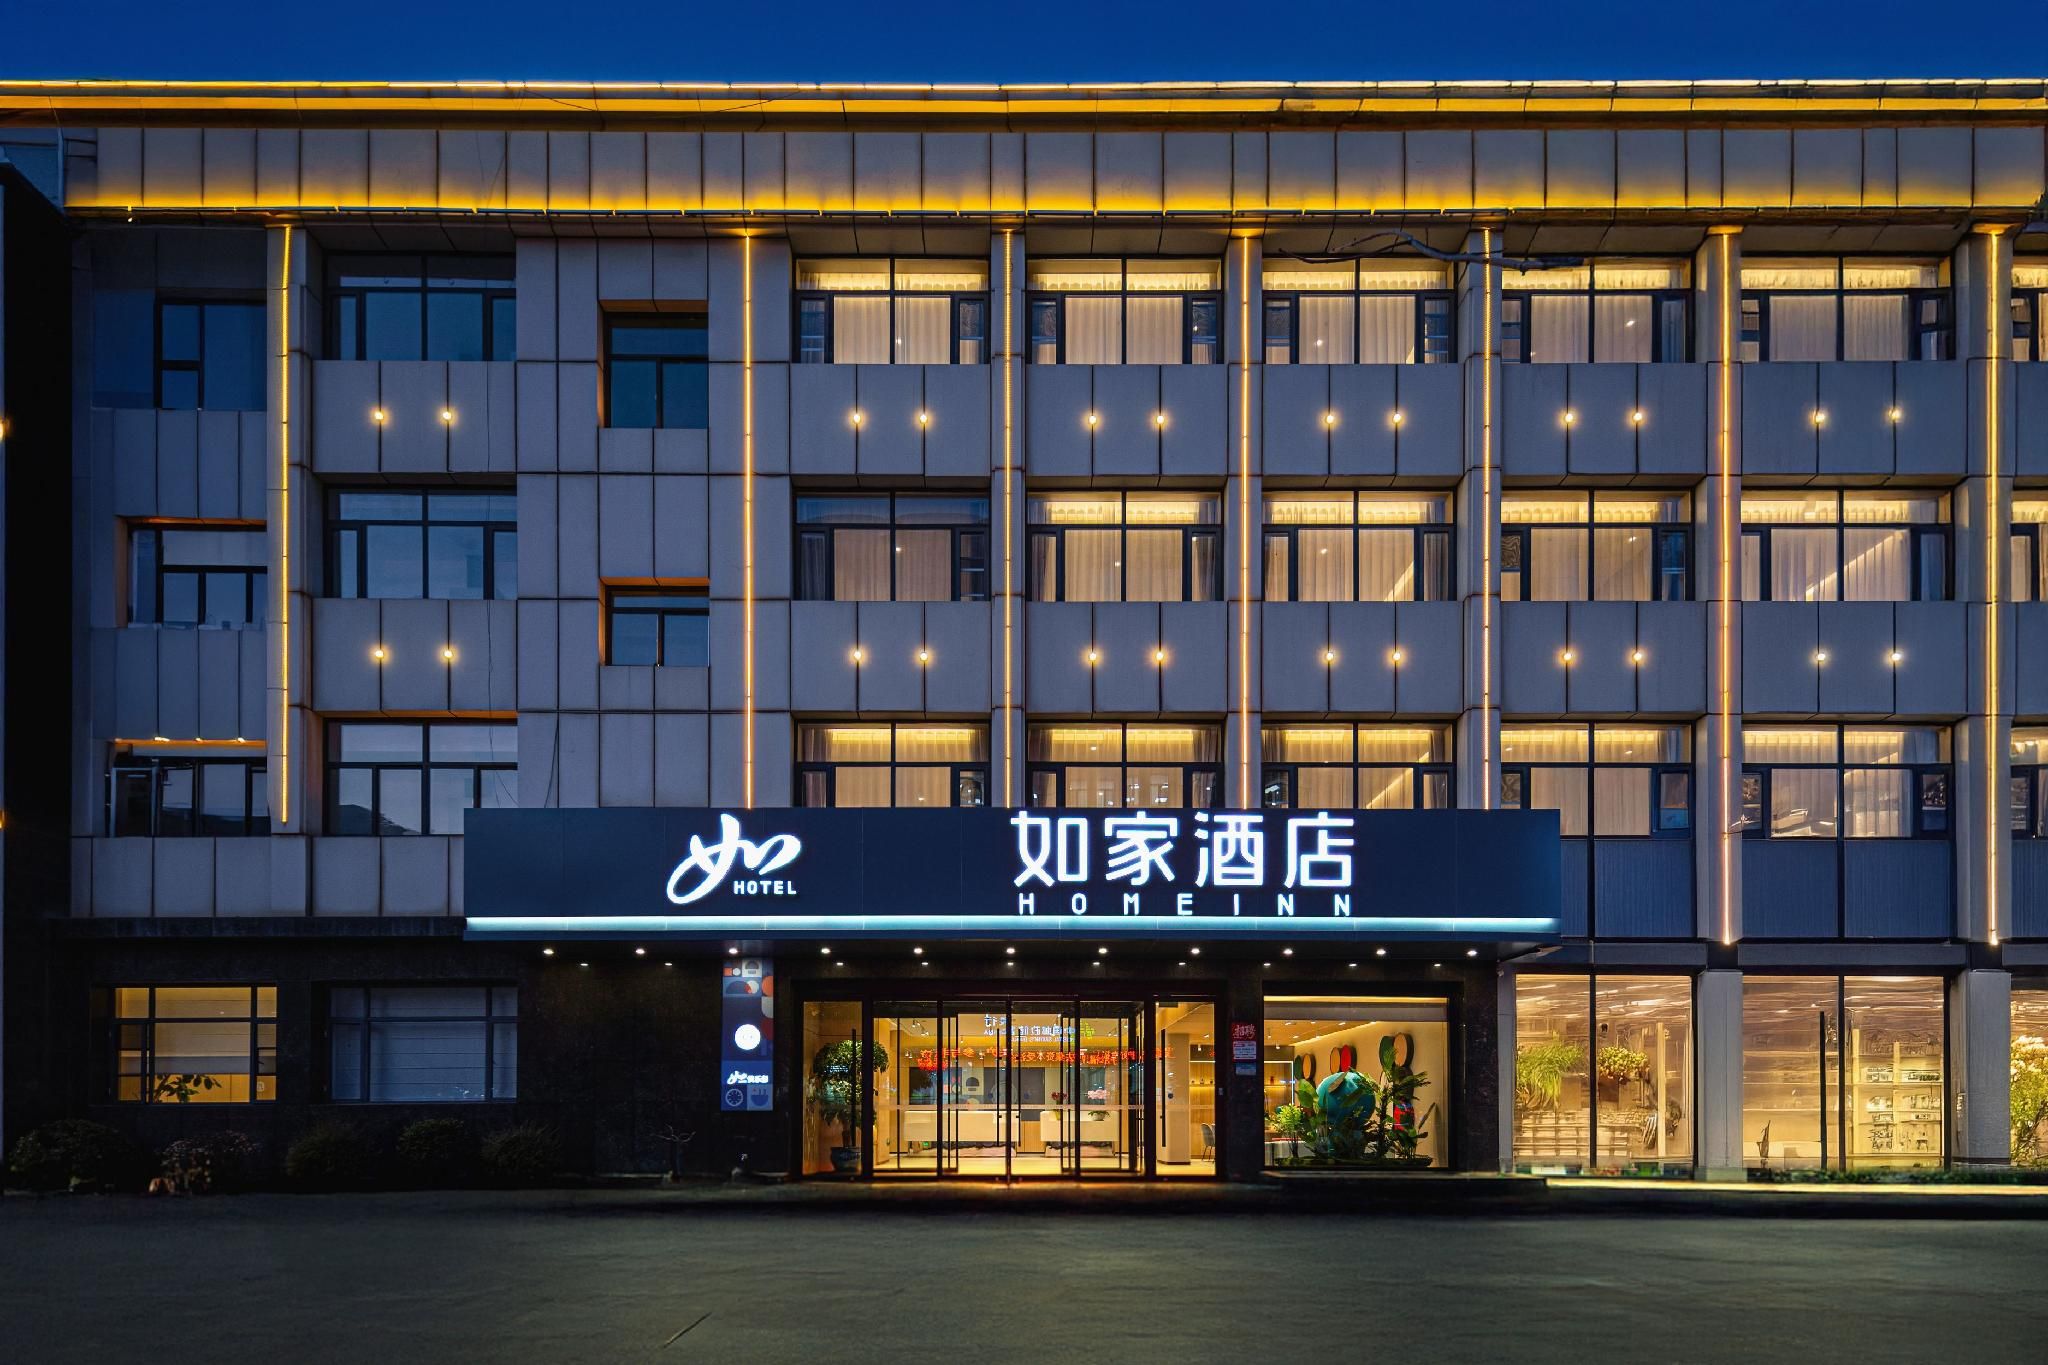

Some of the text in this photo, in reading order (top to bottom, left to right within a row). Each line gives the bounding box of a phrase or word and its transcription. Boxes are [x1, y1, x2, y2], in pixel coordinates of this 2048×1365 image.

[1010, 810, 1355, 888] 如家酒店
[733, 880, 798, 895] HOTEL
